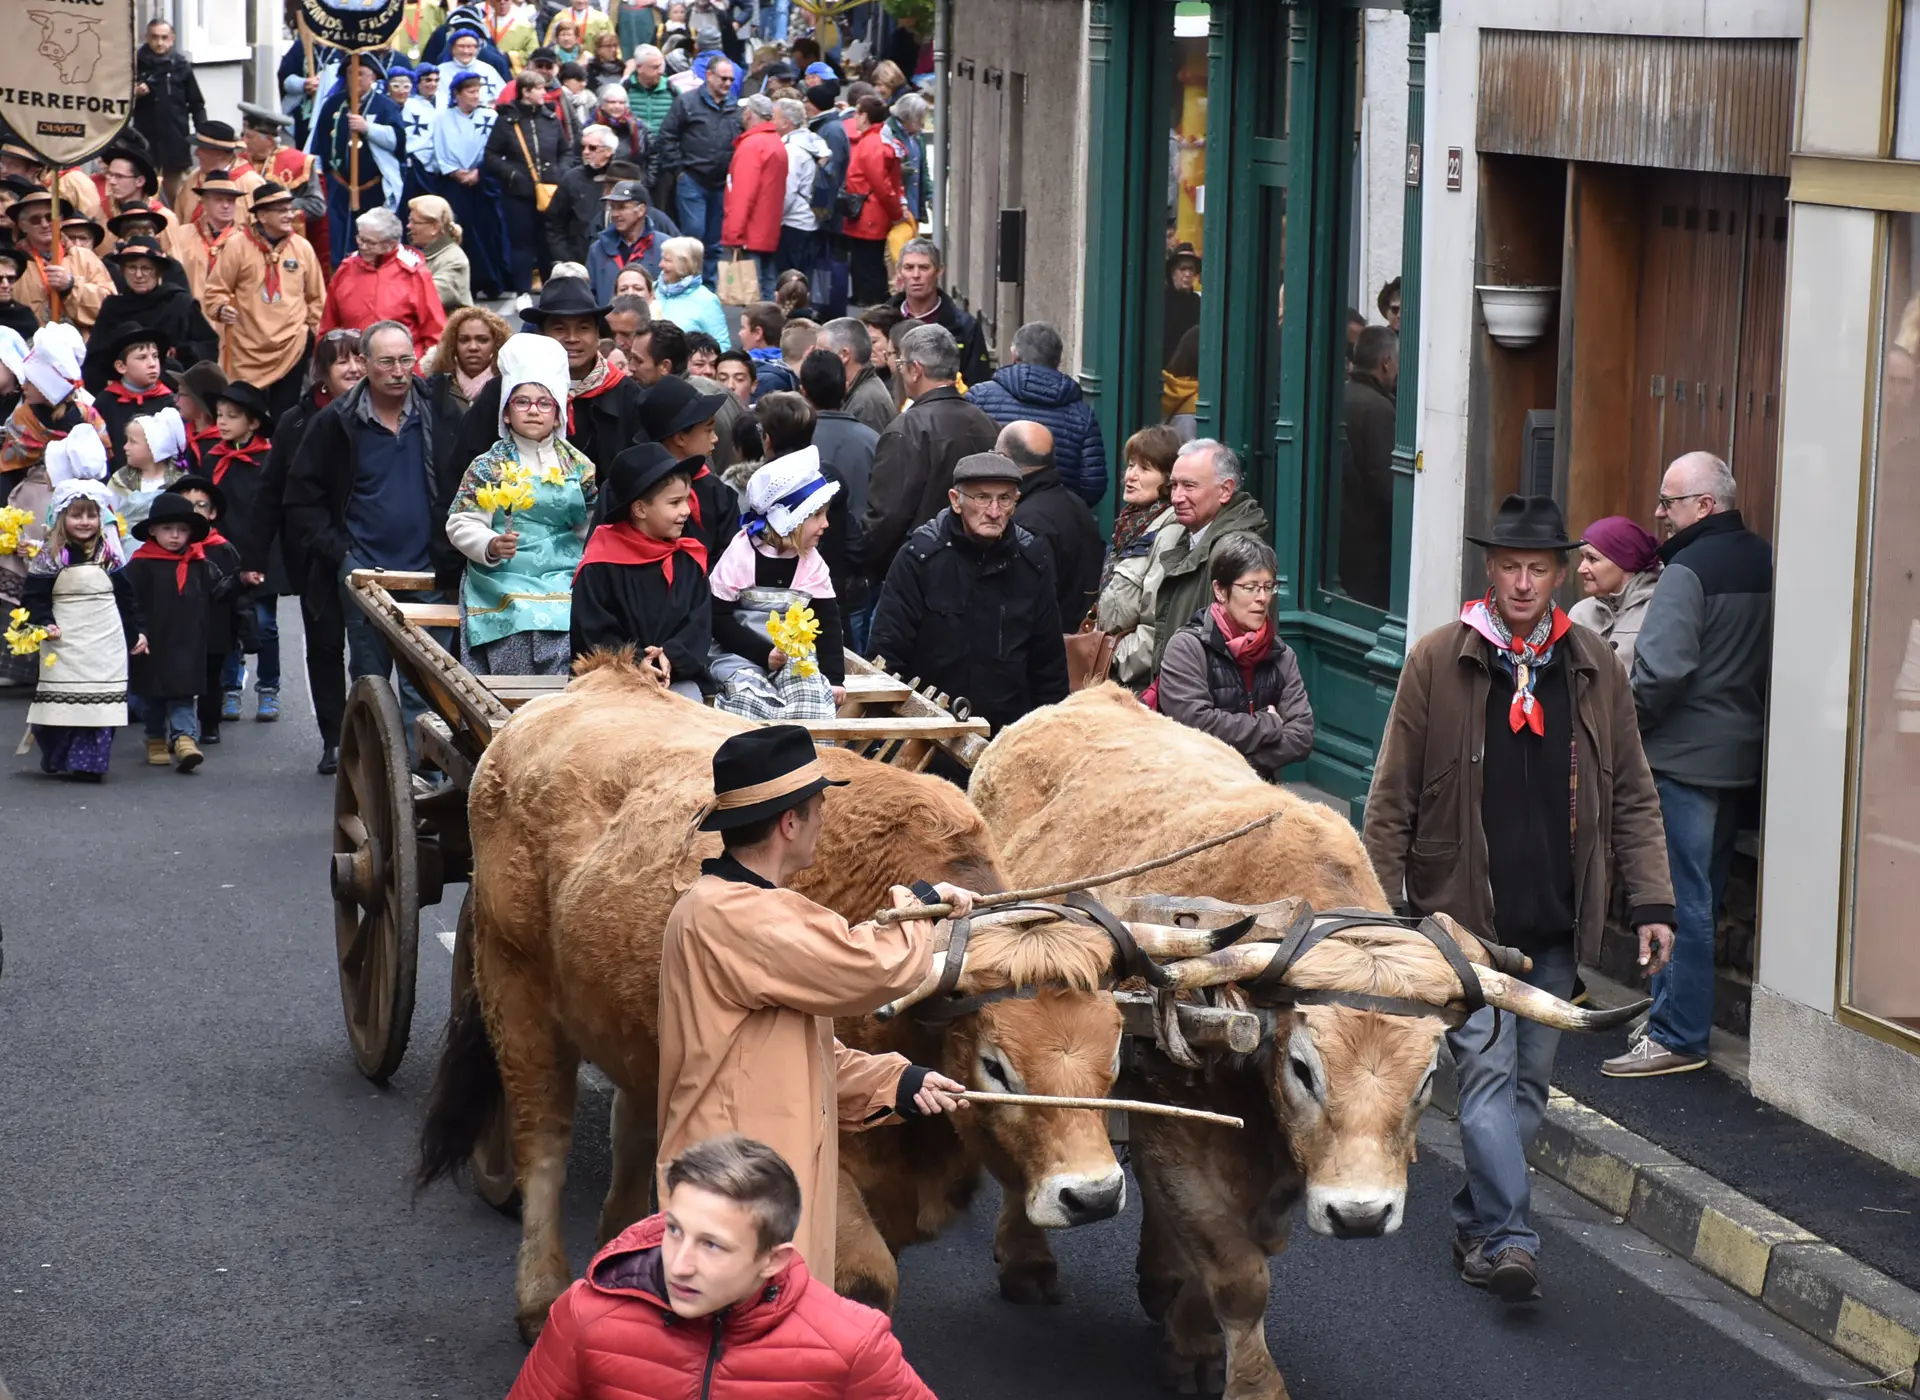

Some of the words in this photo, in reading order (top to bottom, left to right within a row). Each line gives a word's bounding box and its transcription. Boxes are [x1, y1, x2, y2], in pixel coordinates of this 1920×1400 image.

[0, 88, 129, 115] IERREFORT
[1409, 153, 1418, 174] 24
[1448, 157, 1460, 179] 22
